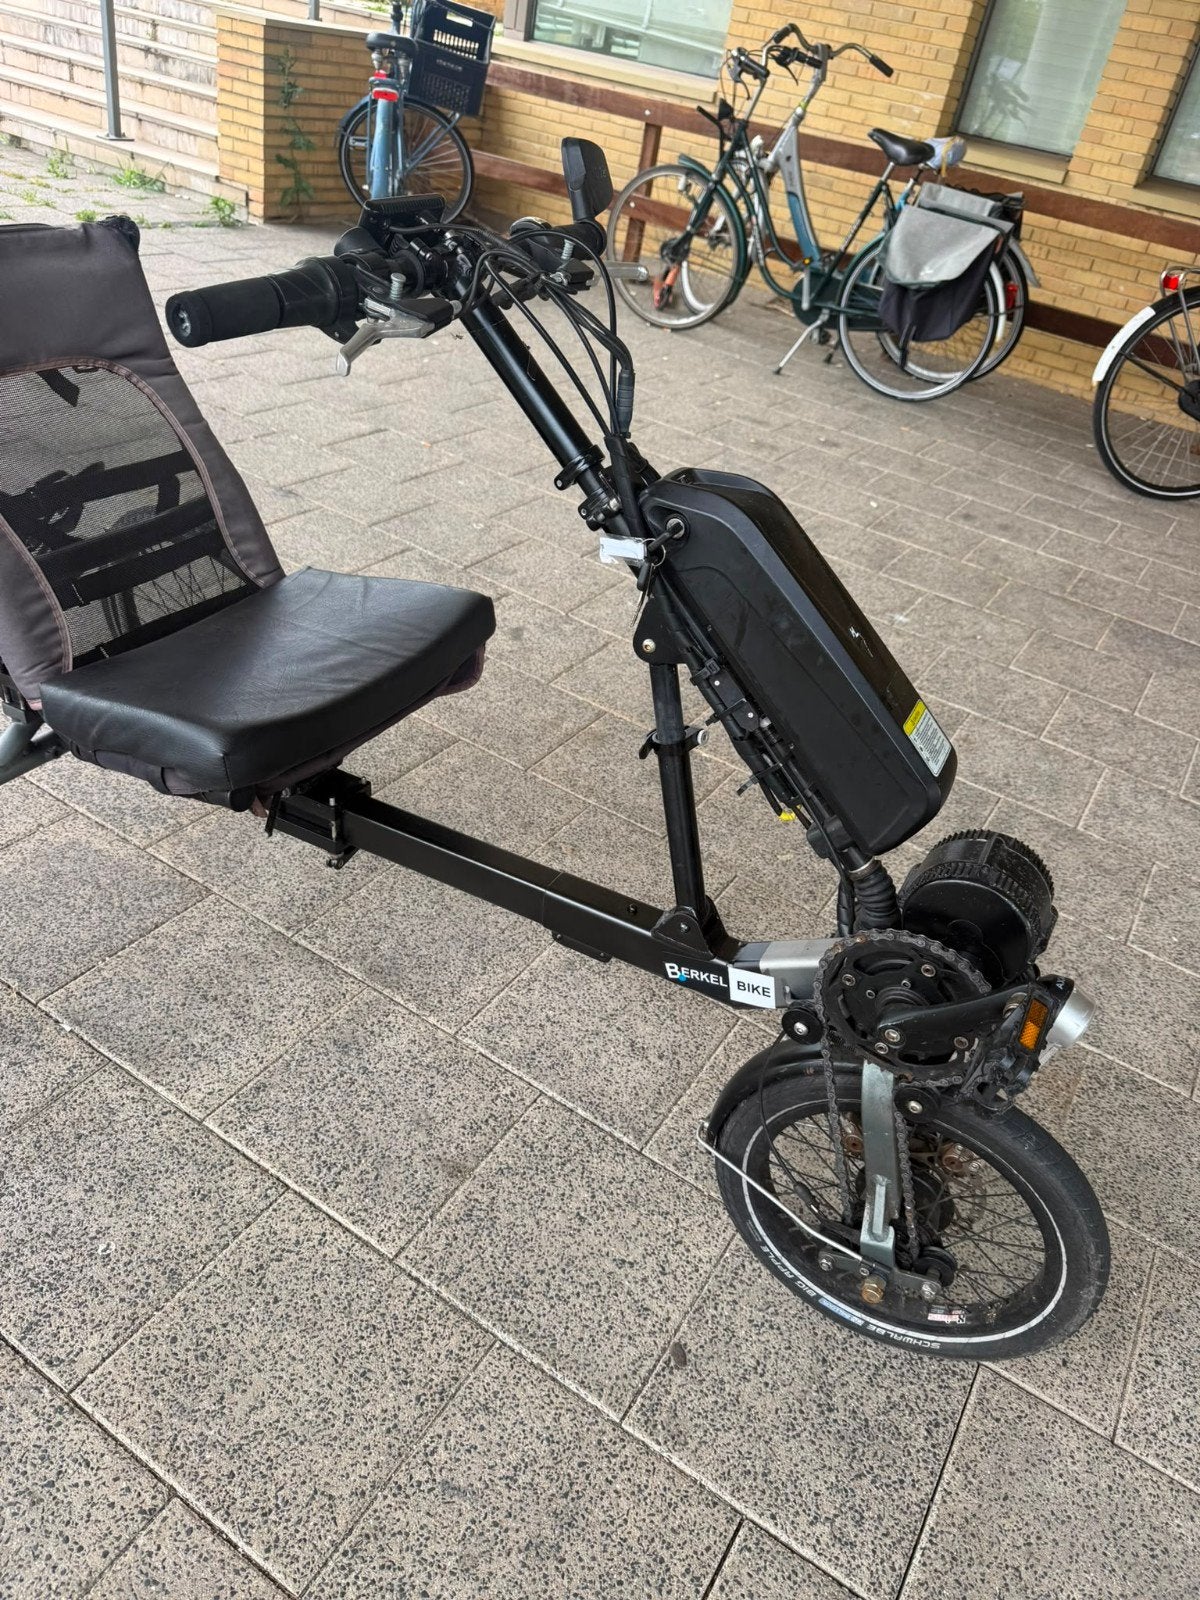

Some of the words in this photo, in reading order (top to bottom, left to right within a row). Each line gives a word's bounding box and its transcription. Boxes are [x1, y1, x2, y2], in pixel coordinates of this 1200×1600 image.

[665, 962, 728, 988] BERKEL
[737, 980, 772, 998] BIKE
[760, 1245, 795, 1279] APPLE
[794, 1280, 817, 1297] BIG
[866, 1323, 941, 1350] SCHWALBE
